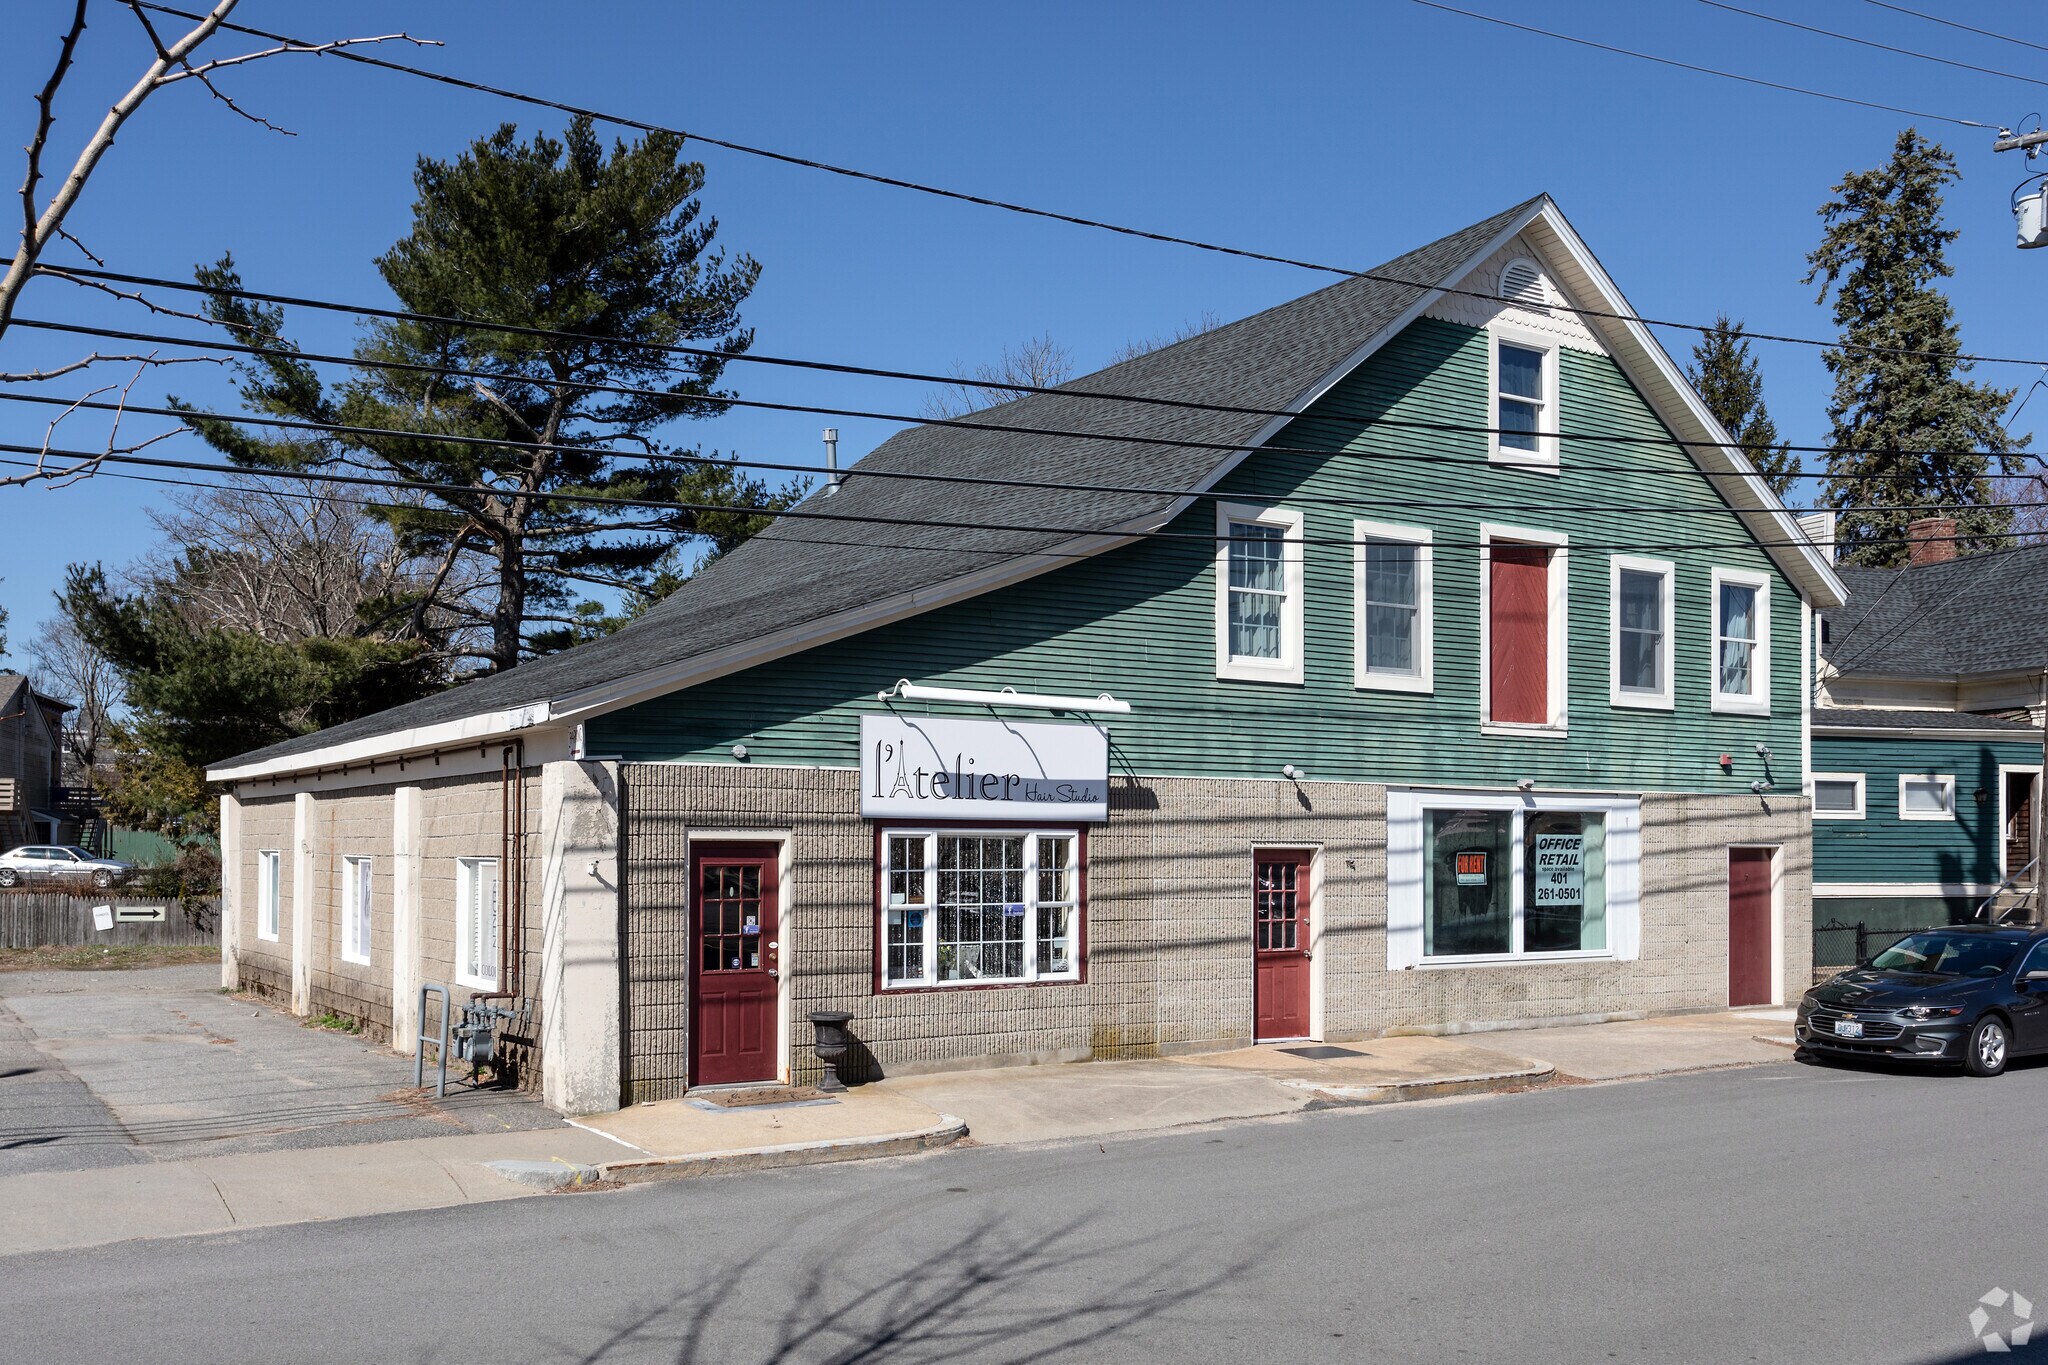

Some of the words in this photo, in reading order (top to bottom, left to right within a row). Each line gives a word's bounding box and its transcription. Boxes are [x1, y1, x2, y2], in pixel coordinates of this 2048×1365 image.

[872, 738, 1020, 801] l'Atelier
[1025, 783, 1055, 803] Hair
[1056, 784, 1099, 803] Studio
[1539, 838, 1581, 850] OFFICE
[1458, 855, 1468, 873] FOR
[1470, 855, 1484, 873] RENT
[1539, 854, 1579, 865] RETAIL
[1551, 873, 1567, 884] 401
[1538, 888, 1580, 899] 261-0501
